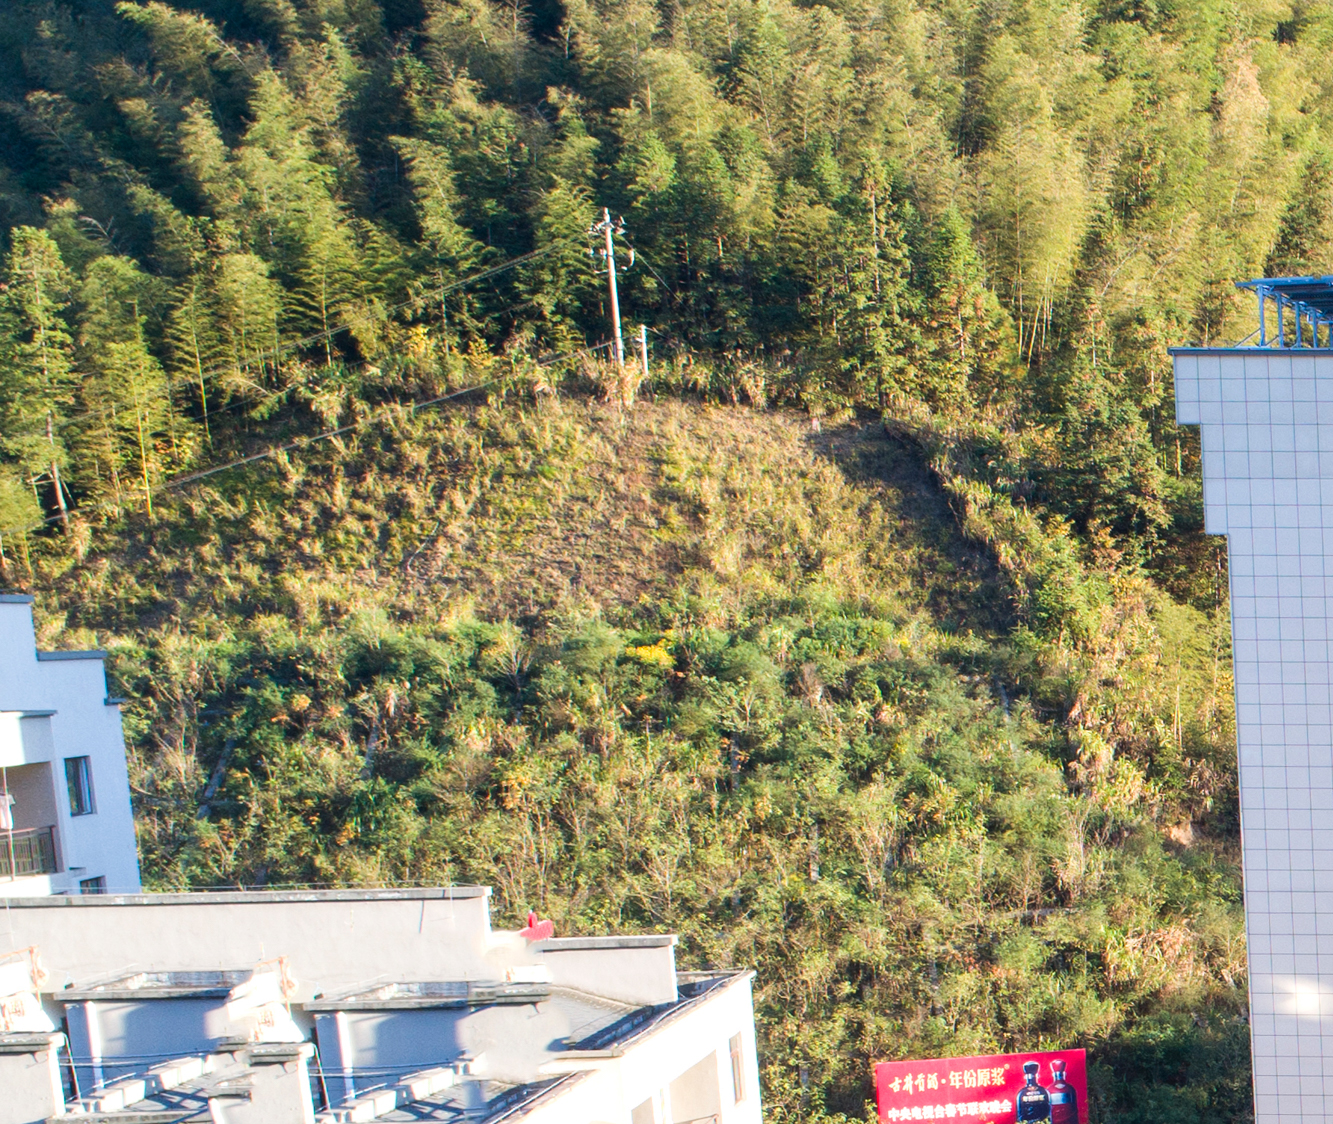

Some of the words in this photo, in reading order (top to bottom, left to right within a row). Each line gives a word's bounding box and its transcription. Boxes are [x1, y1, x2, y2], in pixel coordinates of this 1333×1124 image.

[888, 1098, 1012, 1122] 中央电视台春节联欢晚会
